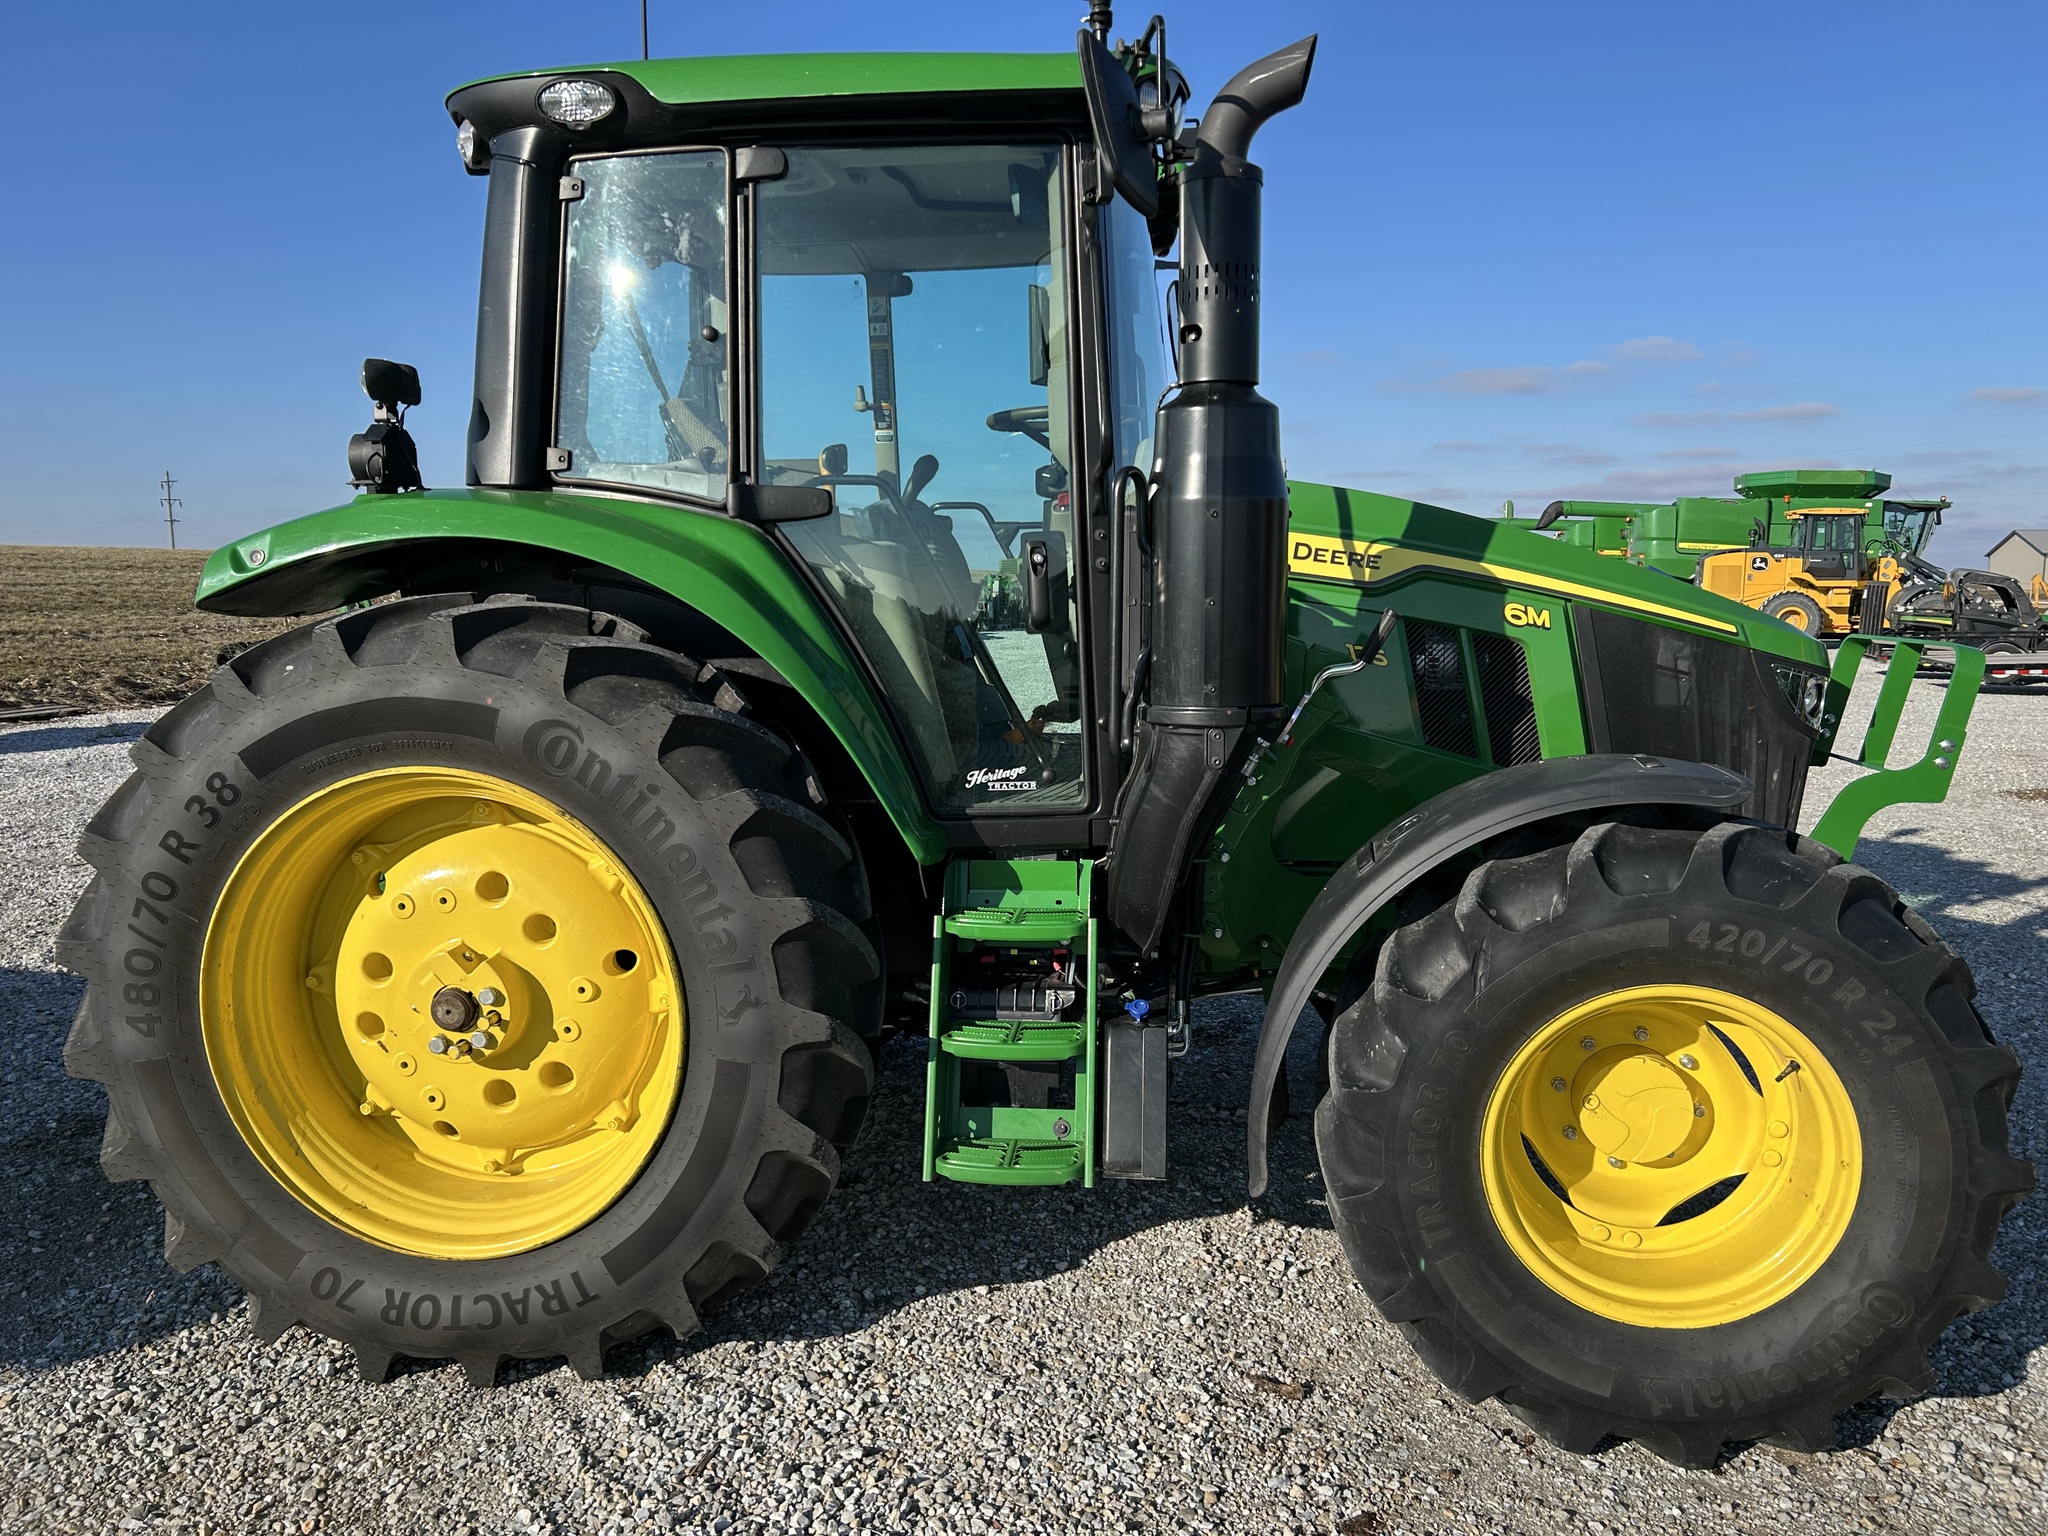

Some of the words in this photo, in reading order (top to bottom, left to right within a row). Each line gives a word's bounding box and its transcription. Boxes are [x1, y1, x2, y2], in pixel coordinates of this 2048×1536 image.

[1293, 542, 1382, 570] DEERE
[1504, 603, 1551, 629] 6M
[1345, 642, 1388, 667] 15
[301, 747, 361, 775] ENGINEERED
[367, 742, 387, 754] FOR
[965, 766, 1027, 788] Heritage
[987, 781, 1037, 791] TRACTOR
[522, 719, 757, 981] Continental
[123, 871, 178, 1039] 480/70
[158, 829, 201, 867] R
[184, 771, 242, 831] 38
[1686, 921, 1834, 986] 420/70
[1831, 976, 1866, 1010] R
[1861, 1009, 1915, 1056] 24
[1408, 1083, 1450, 1249] TRACTOR
[1430, 1030, 1474, 1074] 70
[310, 1266, 366, 1315] 70
[380, 1270, 600, 1332] TRACTOR
[1681, 1280, 1915, 1417] Continental
